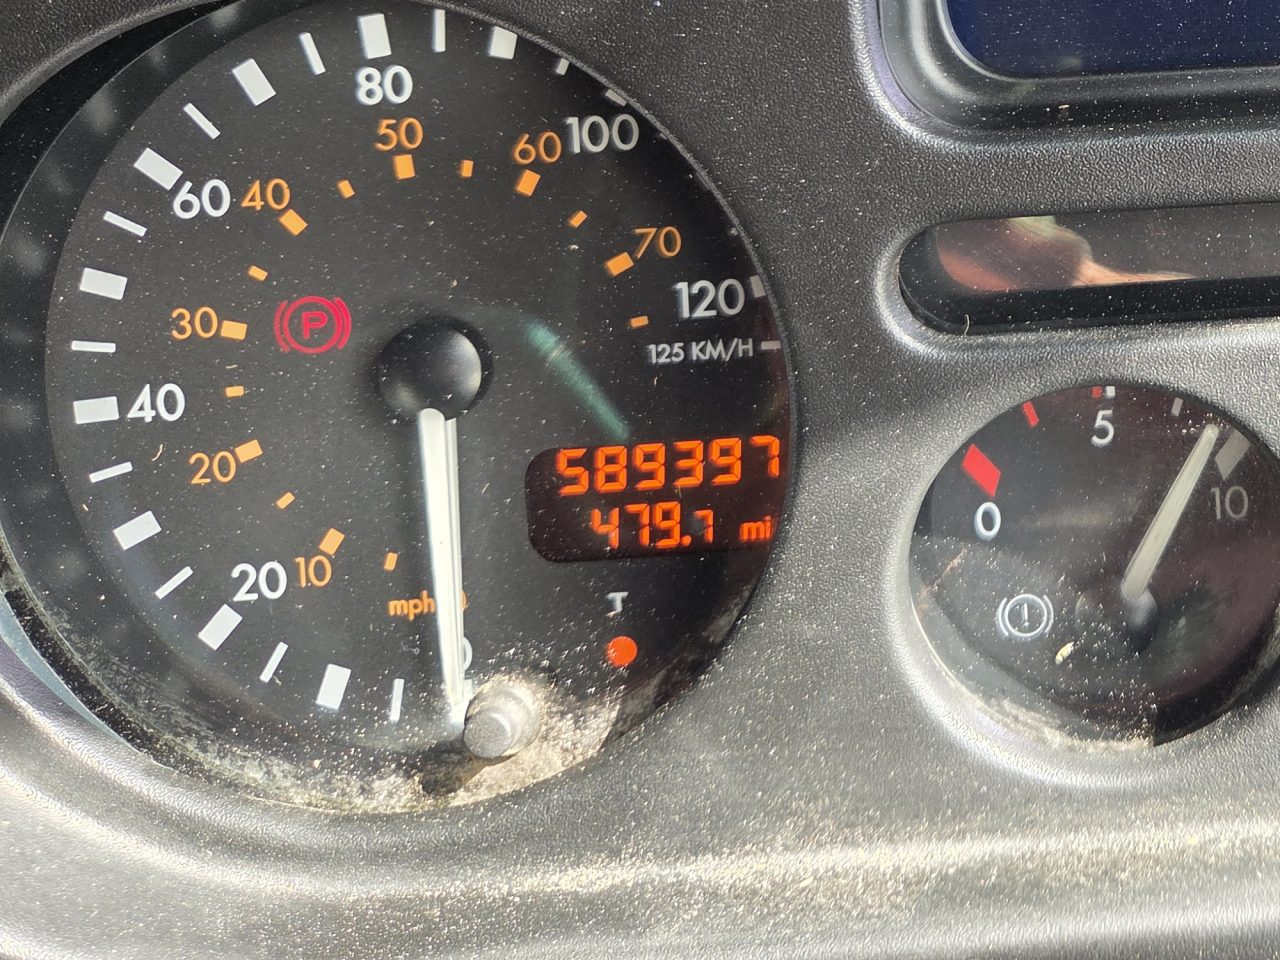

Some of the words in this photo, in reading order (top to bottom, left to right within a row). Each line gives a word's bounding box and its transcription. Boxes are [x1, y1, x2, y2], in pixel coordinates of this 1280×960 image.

[356, 65, 413, 105] 80
[374, 117, 424, 151] 50
[514, 131, 562, 165] 60
[565, 114, 639, 154] 100
[173, 179, 231, 219] 60
[240, 178, 291, 211] 40
[633, 226, 682, 258] 70
[675, 278, 745, 319] 120
[170, 306, 218, 340] 30
[649, 343, 685, 364] 125
[691, 338, 754, 362] KM/H
[127, 383, 185, 422] 40
[1091, 410, 1114, 447] 5
[189, 451, 237, 484] 20
[555, 435, 780, 496] 589397
[1210, 486, 1249, 520] 10
[590, 501, 713, 550] 479.7
[739, 515, 772, 543] mi
[975, 502, 1001, 540] 0
[231, 561, 287, 601] 20
[295, 555, 332, 587] 10
[388, 590, 436, 621] mph
